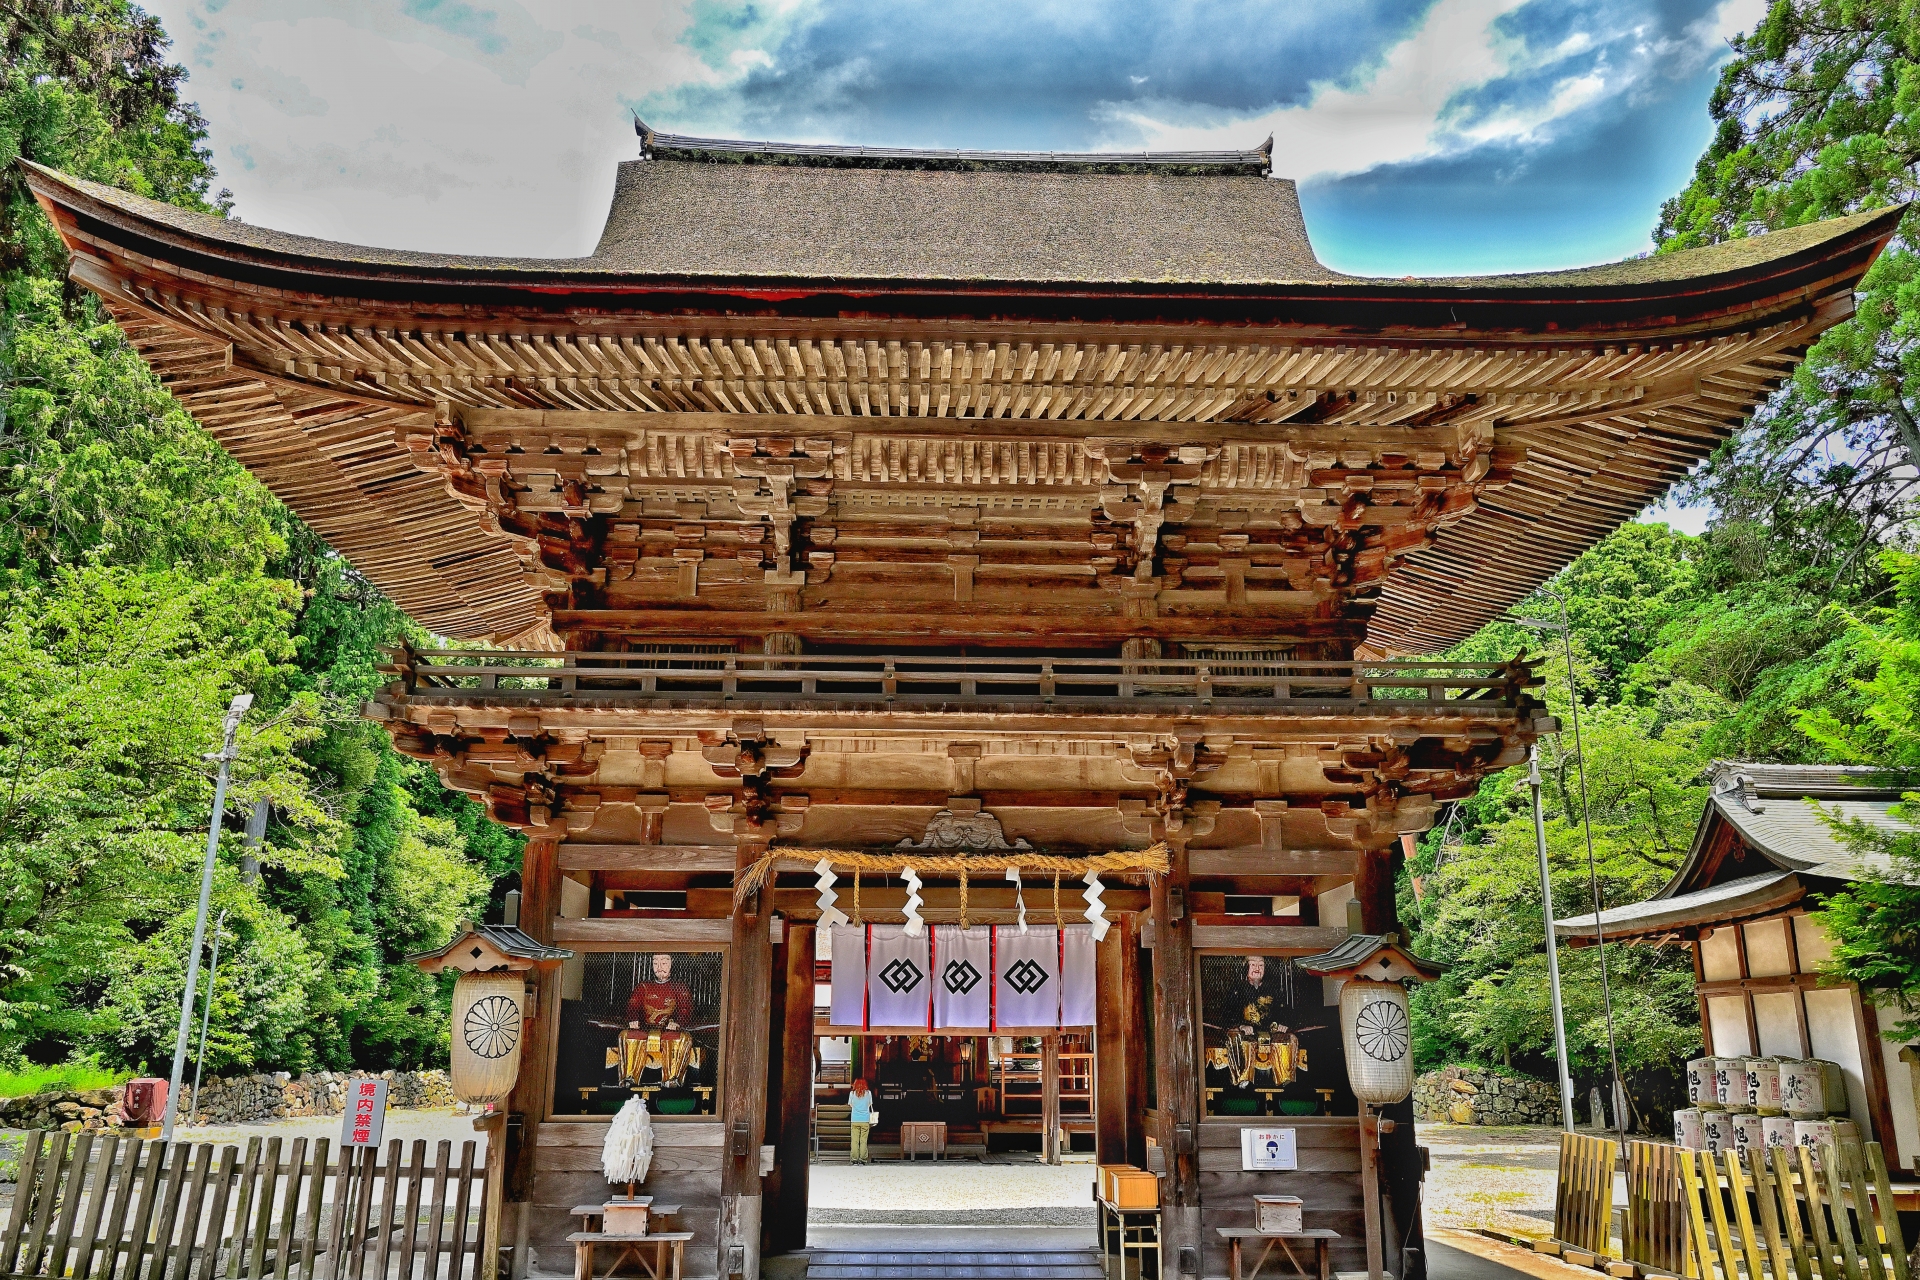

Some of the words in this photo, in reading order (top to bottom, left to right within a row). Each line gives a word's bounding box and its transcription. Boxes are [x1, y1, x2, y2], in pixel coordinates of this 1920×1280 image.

[352, 1082, 377, 1143] 境内禁煙
[1747, 1071, 1761, 1107] 旭日
